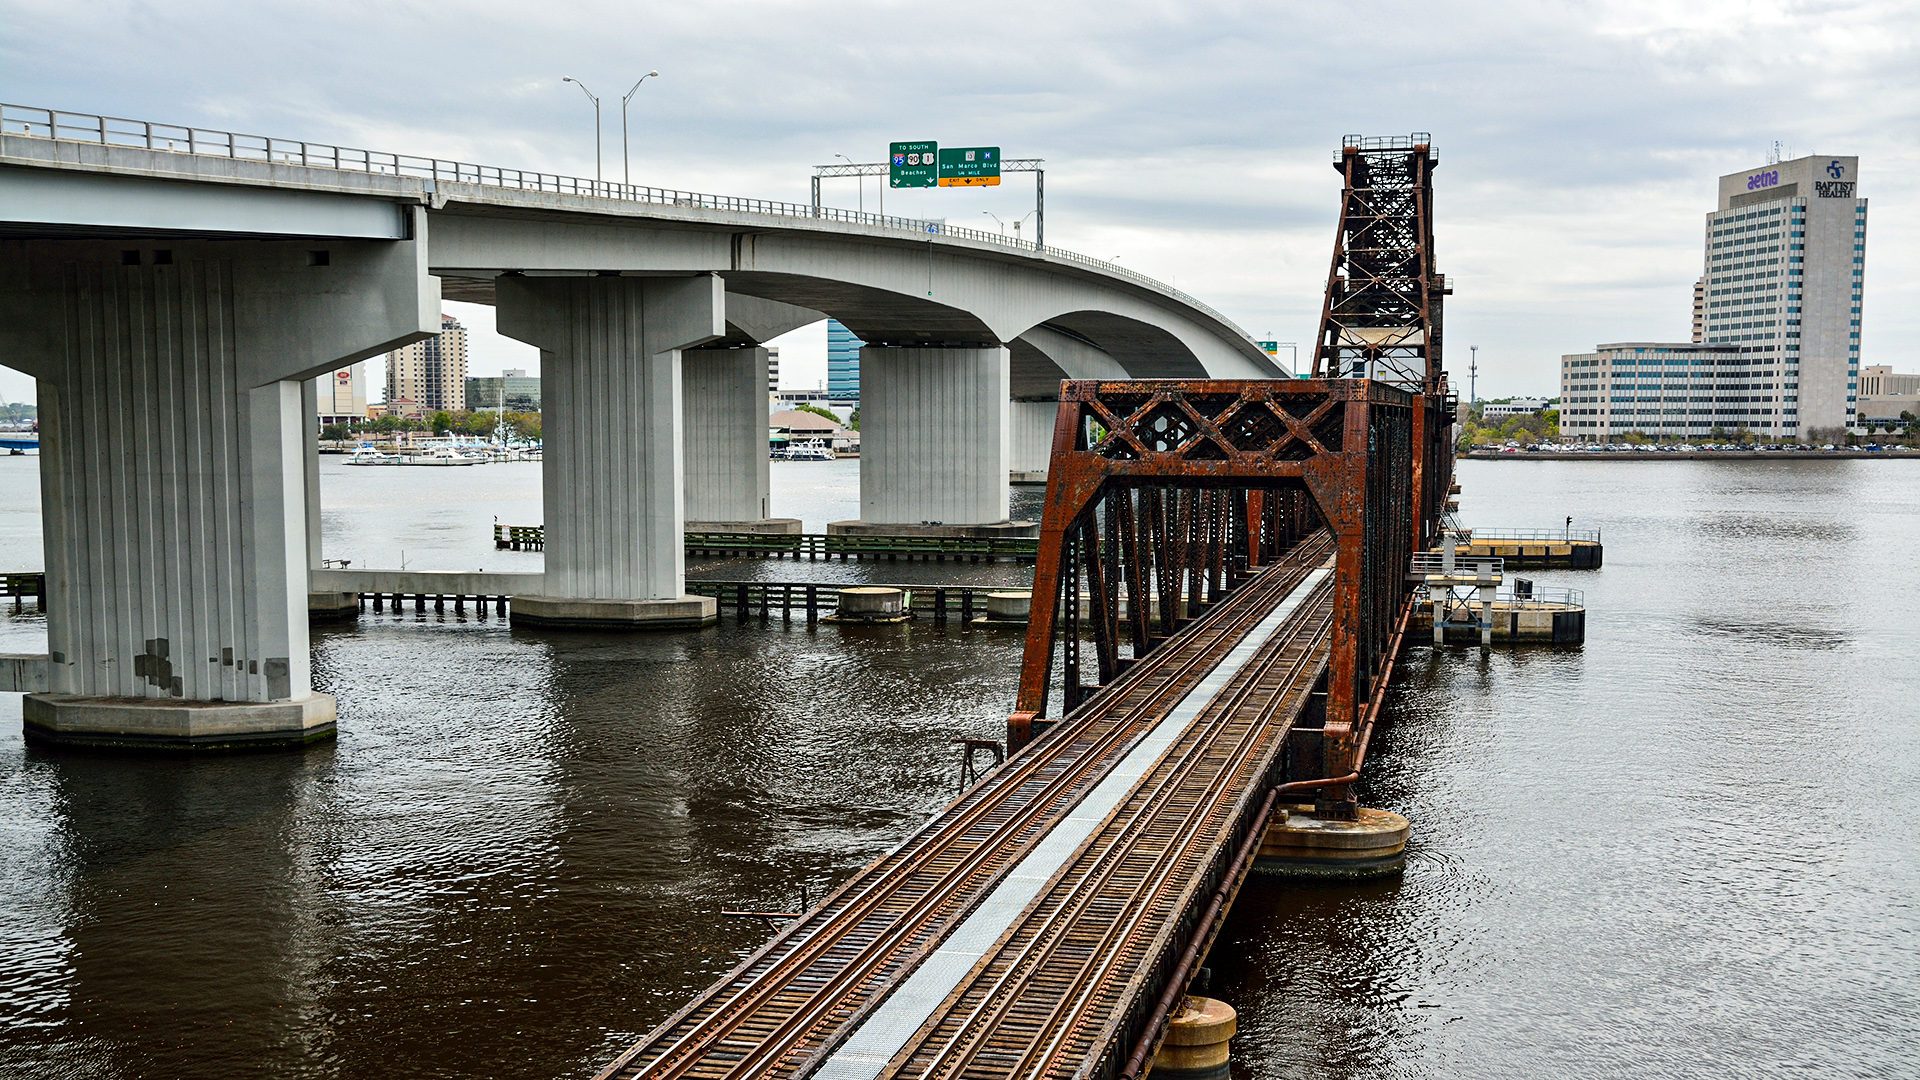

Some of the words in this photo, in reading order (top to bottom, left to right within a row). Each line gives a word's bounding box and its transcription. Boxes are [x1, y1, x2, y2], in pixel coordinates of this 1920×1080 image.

[894, 156, 904, 164] 95
[908, 155, 918, 163] 90
[1747, 170, 1779, 190] aetna
[1815, 181, 1855, 191] BAPTIST
[1818, 190, 1851, 198] HEALTH
